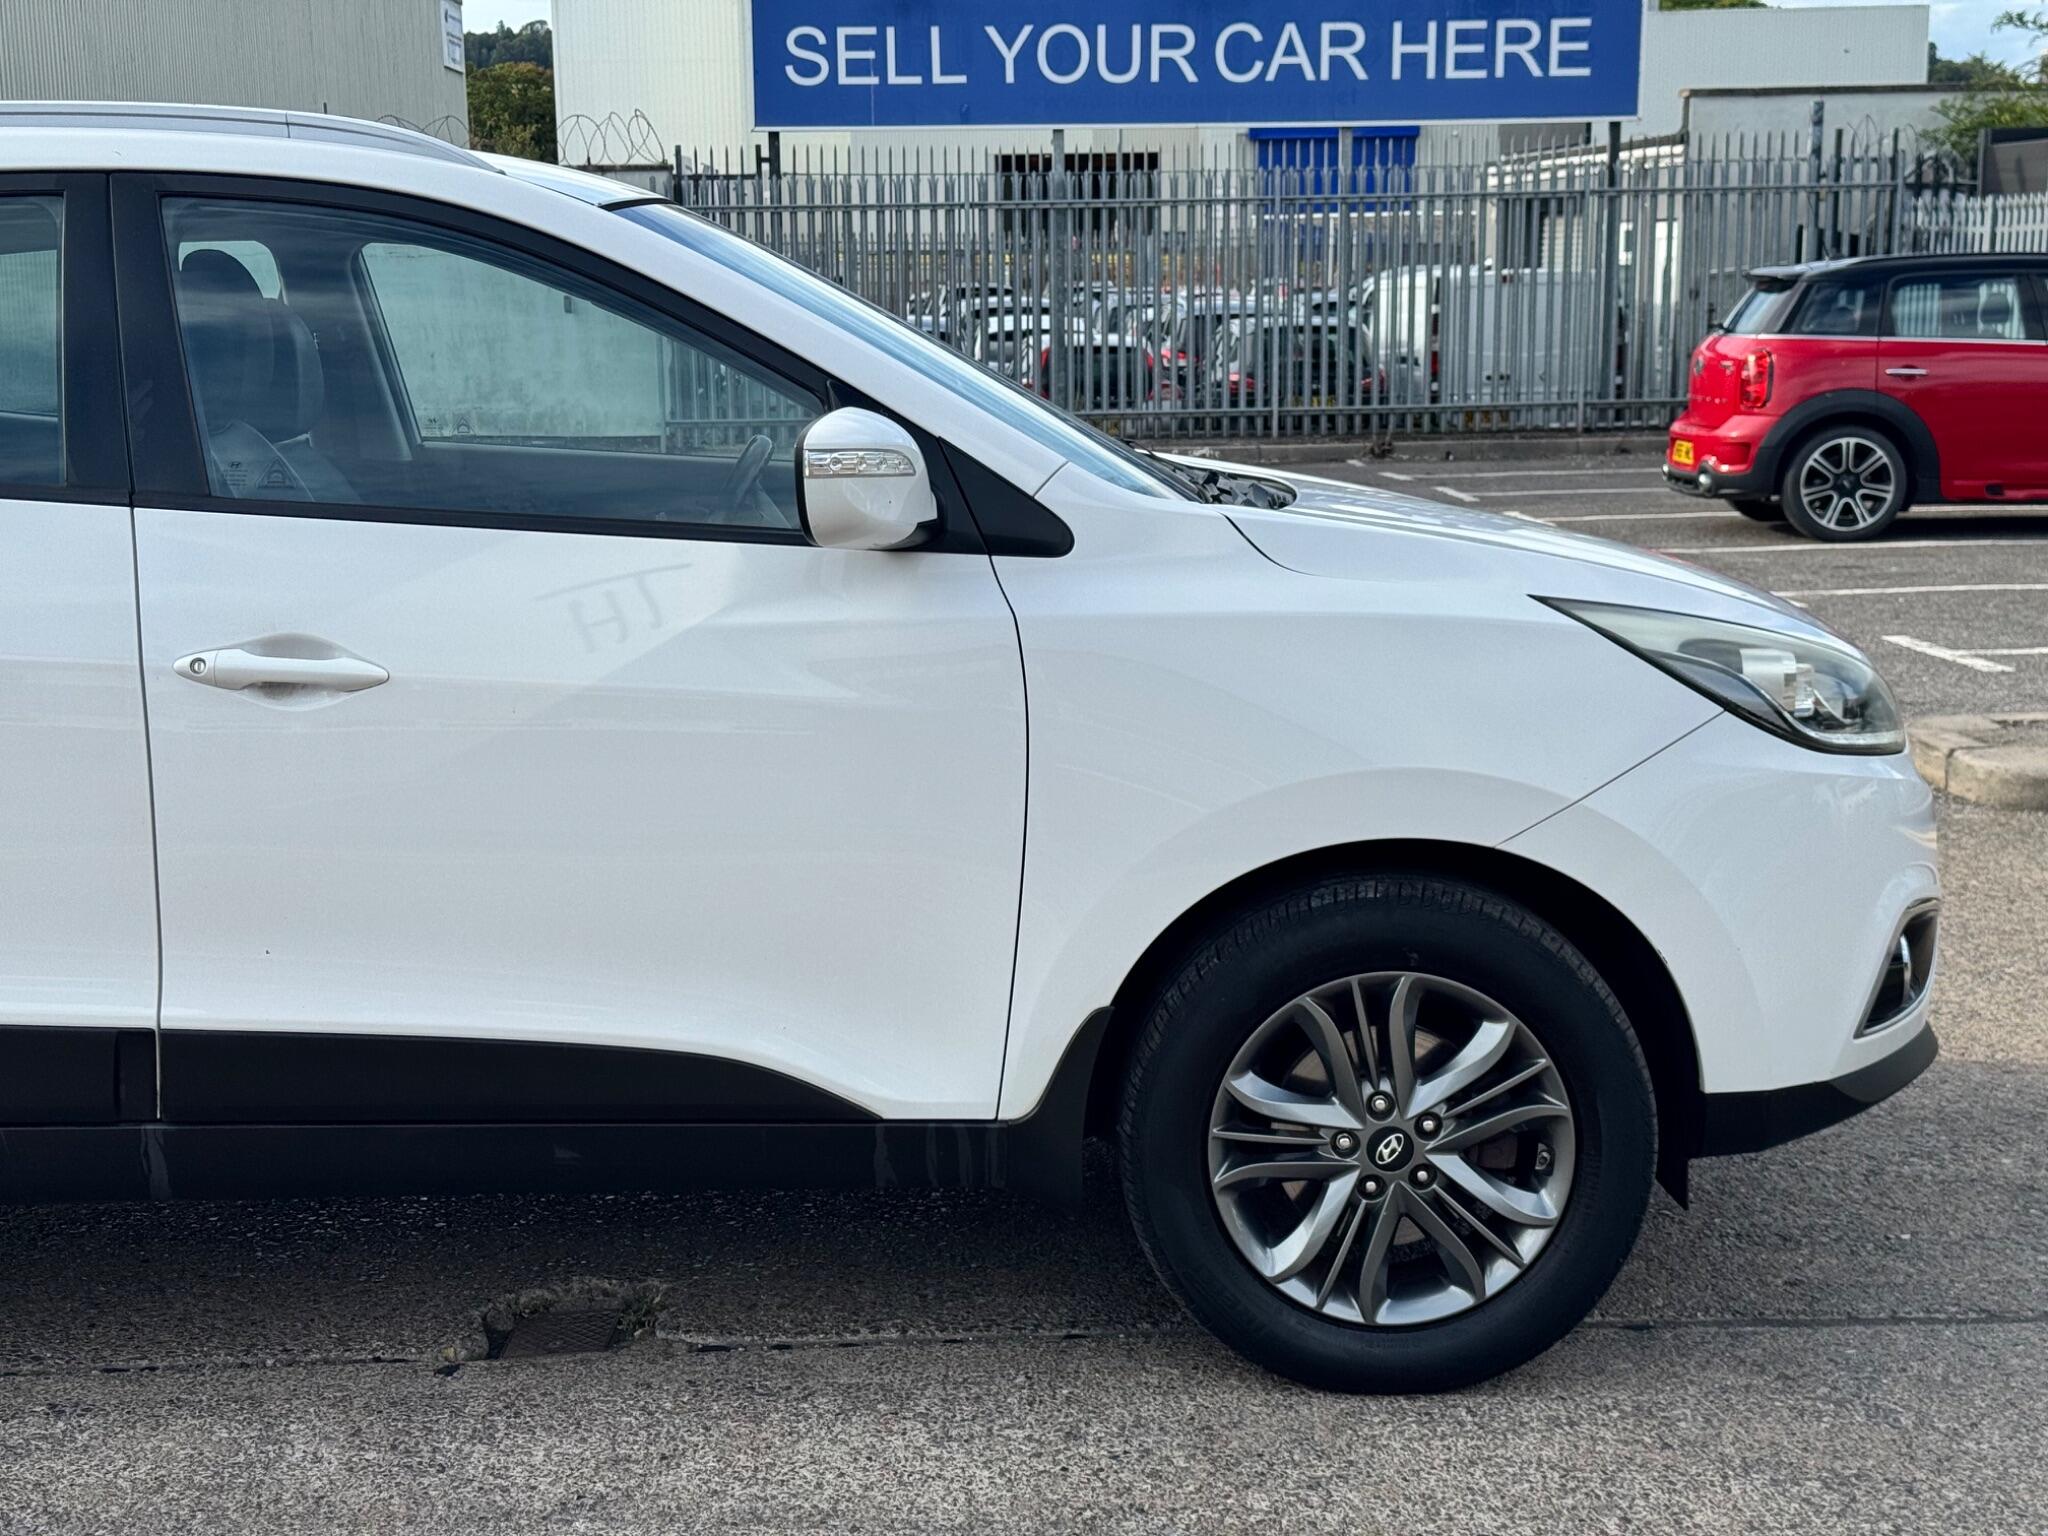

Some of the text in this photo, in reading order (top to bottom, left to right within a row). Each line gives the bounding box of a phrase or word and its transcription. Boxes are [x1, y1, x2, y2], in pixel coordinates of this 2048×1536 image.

[785, 18, 1591, 86] SELL YOUR CAR HERE
